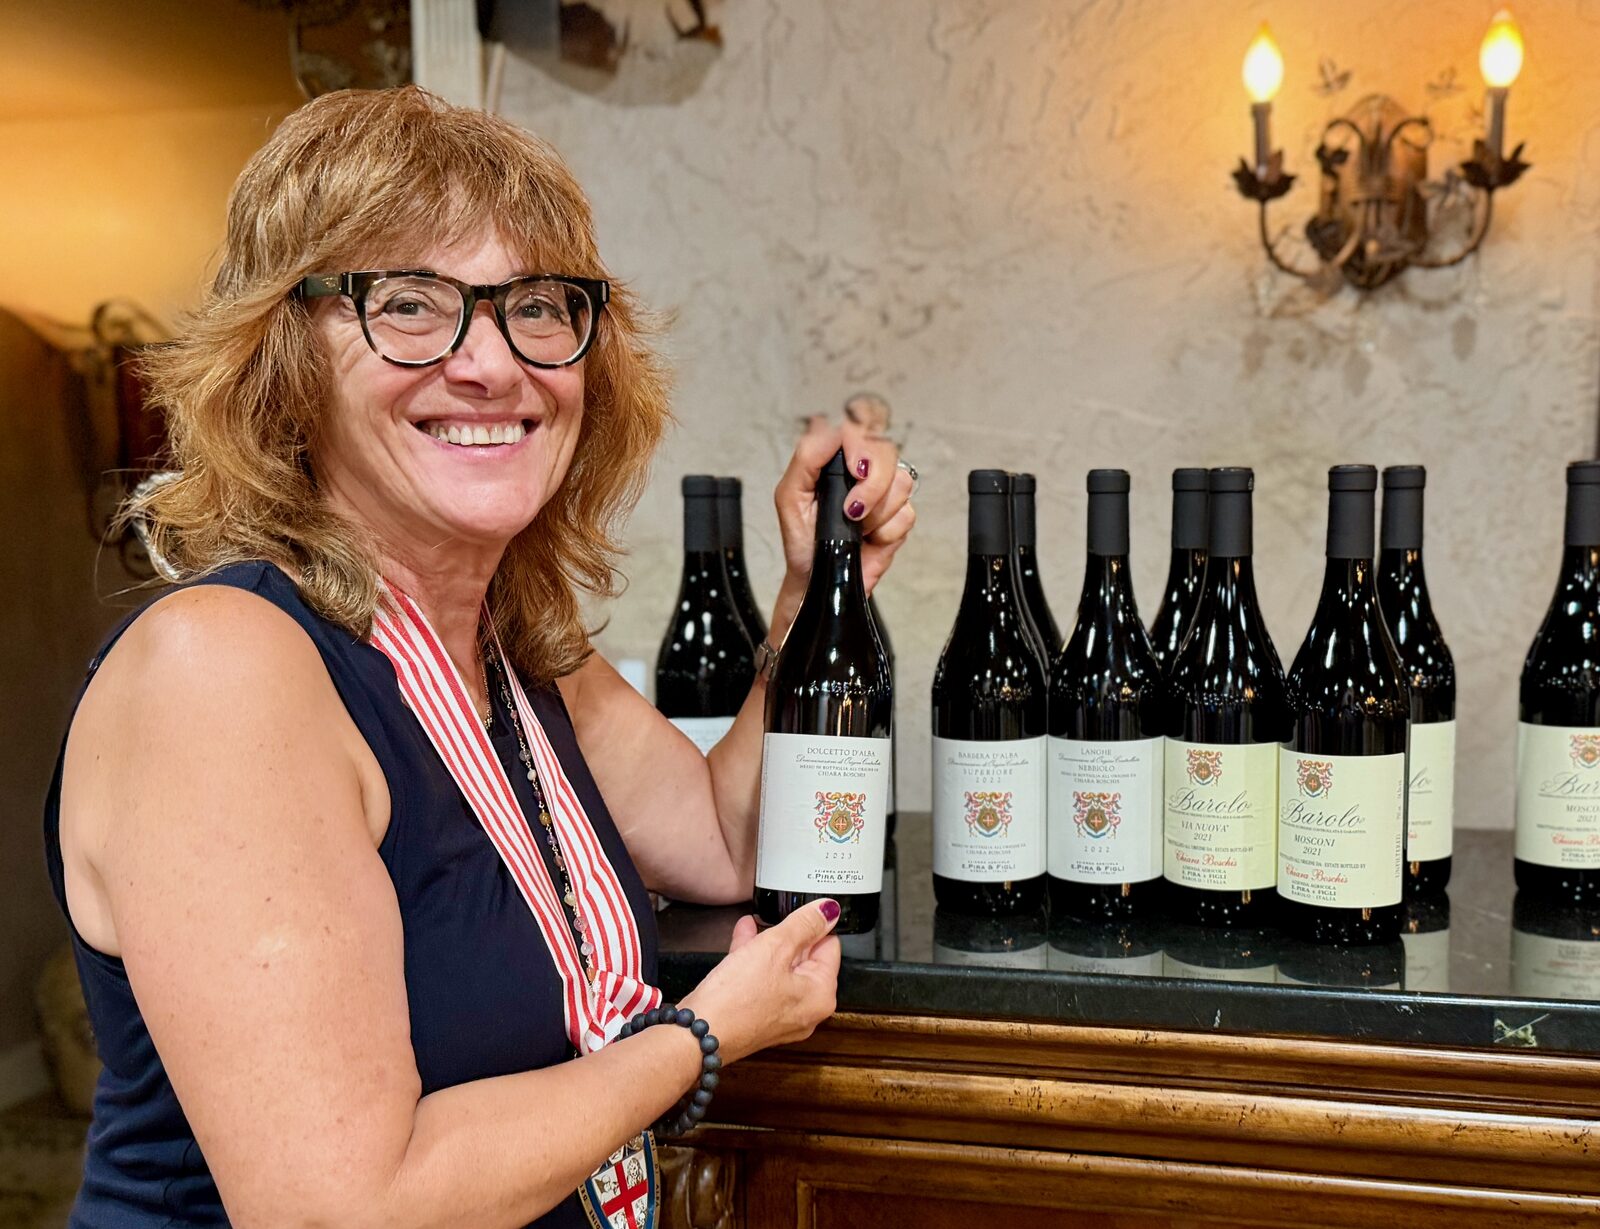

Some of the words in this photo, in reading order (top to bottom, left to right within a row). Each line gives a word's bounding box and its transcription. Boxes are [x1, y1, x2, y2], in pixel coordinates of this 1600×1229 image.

[807, 747, 850, 756] DOLCETTO
[852, 749, 876, 757] D'ALBA
[1081, 748, 1112, 756] LANGHE
[1078, 764, 1115, 772] NEBBIOLO
[1168, 787, 1253, 814] Barolo
[1280, 798, 1365, 828] Barolo
[1566, 804, 1600, 813] MOSCO
[1193, 833, 1212, 842] 2021
[1294, 834, 1335, 847] MOSCONI
[1302, 847, 1321, 856] 2021
[1175, 849, 1200, 865] Chiara
[1202, 854, 1238, 867] Boschis
[1285, 863, 1309, 879] Chiara
[1311, 869, 1348, 883] Boschis
